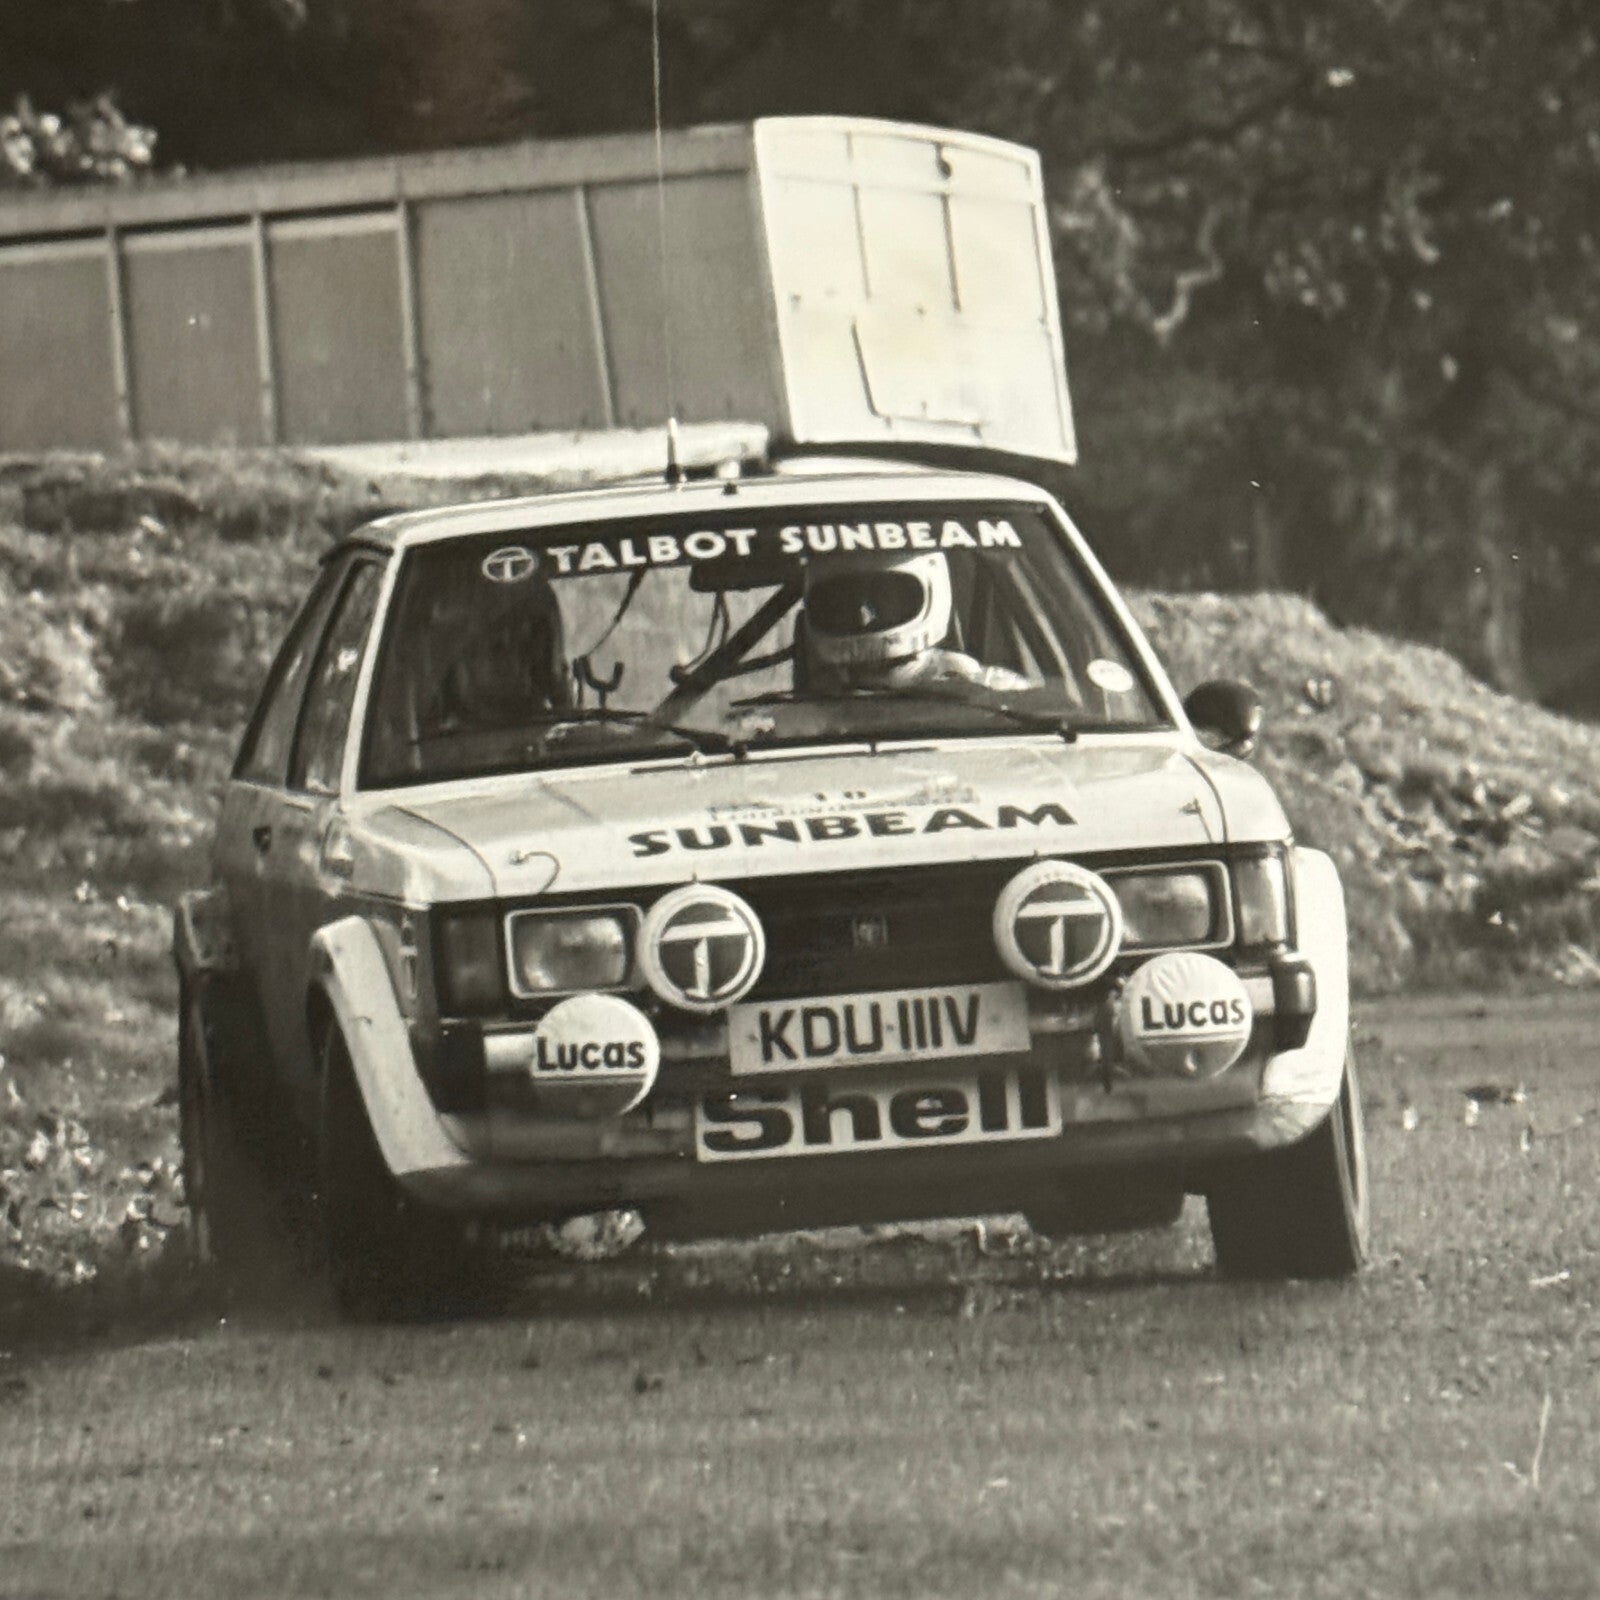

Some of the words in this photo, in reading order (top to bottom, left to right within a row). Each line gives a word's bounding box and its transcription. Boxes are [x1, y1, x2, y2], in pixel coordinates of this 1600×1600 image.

[547, 528, 757, 573] TALBOT
[779, 520, 1022, 553] SUNBEAM
[628, 803, 1077, 857] SUNBEAM
[759, 1001, 884, 1063] KDU
[1141, 995, 1246, 1031] Lucas
[537, 1036, 645, 1071] Lucas
[702, 1071, 1049, 1151] Shell
